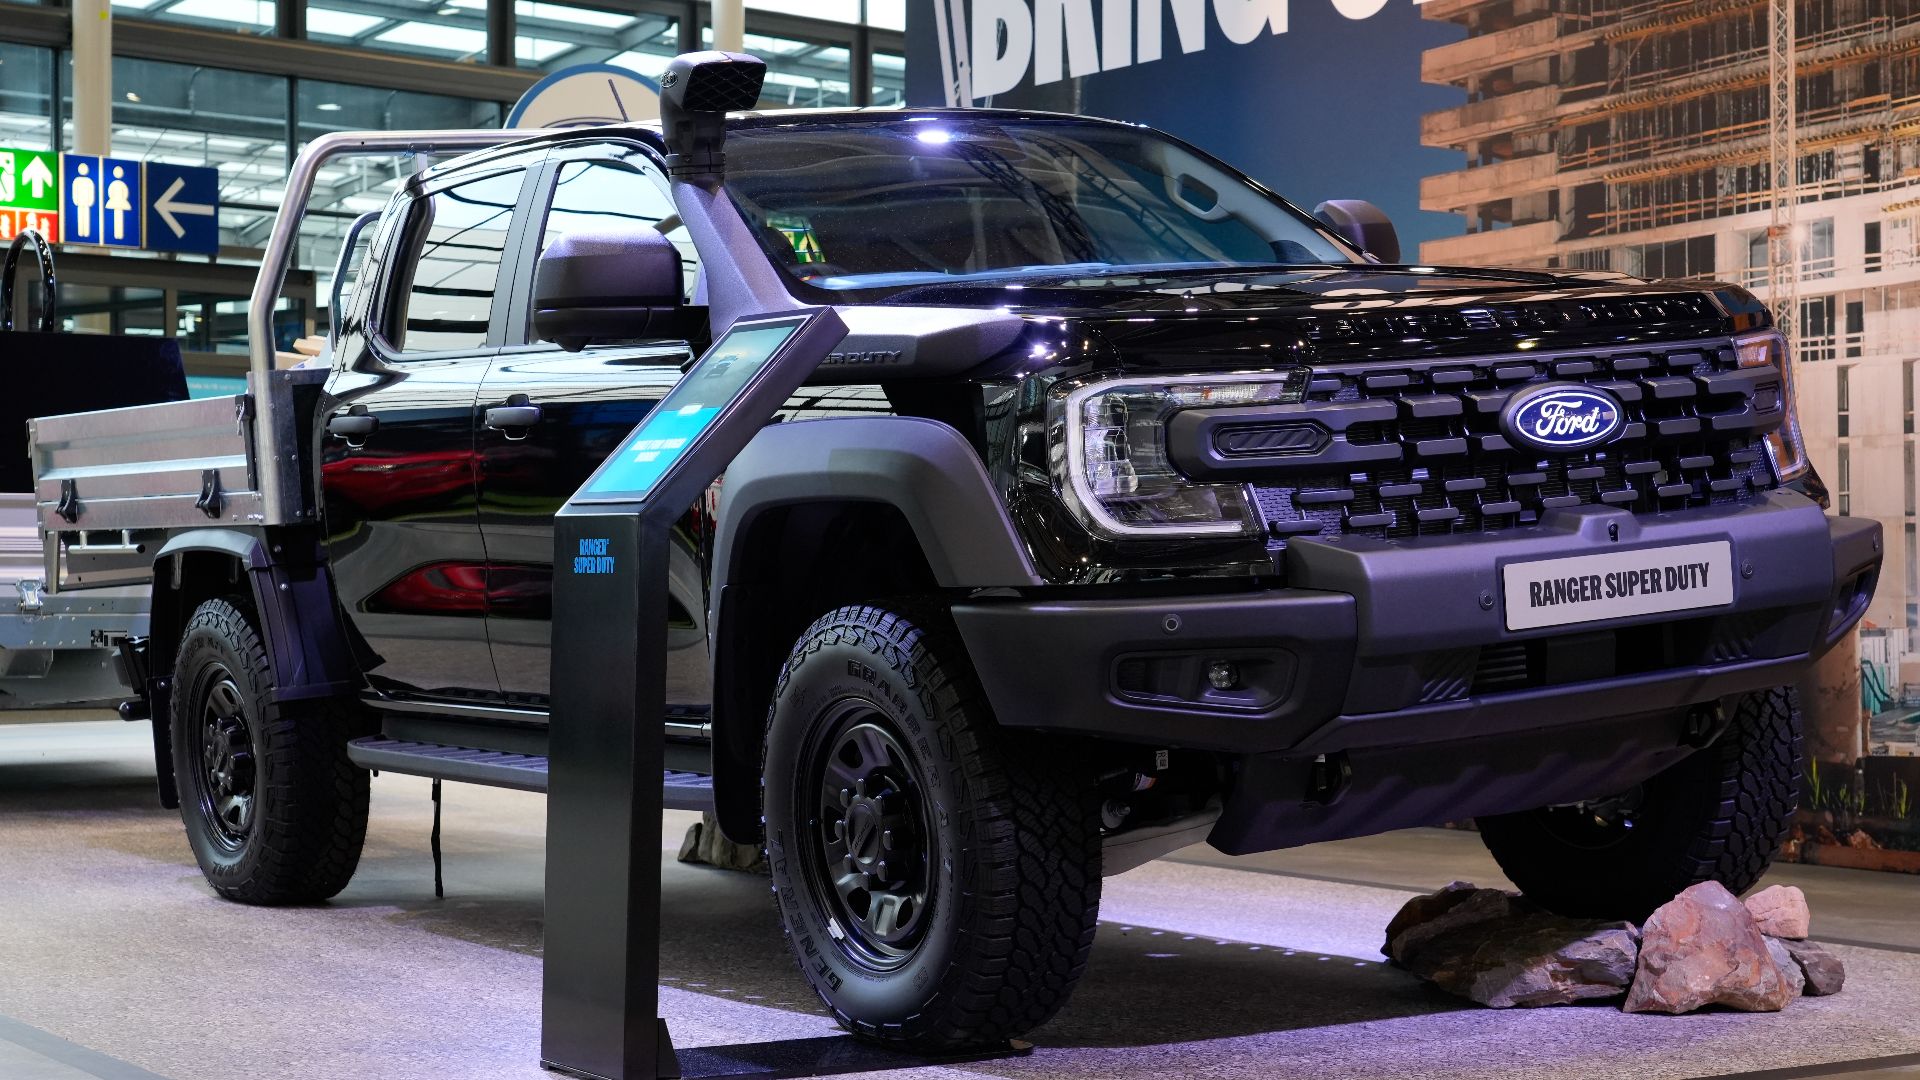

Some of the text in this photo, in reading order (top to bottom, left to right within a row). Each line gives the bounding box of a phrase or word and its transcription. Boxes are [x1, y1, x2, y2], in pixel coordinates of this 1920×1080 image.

[847, 350, 902, 364] DUTY
[1536, 400, 1600, 437] Ford
[574, 556, 615, 574] SUPER DUTY
[1529, 561, 1710, 608] RANGER SUPER DUTY
[769, 827, 844, 993] GENERAL
